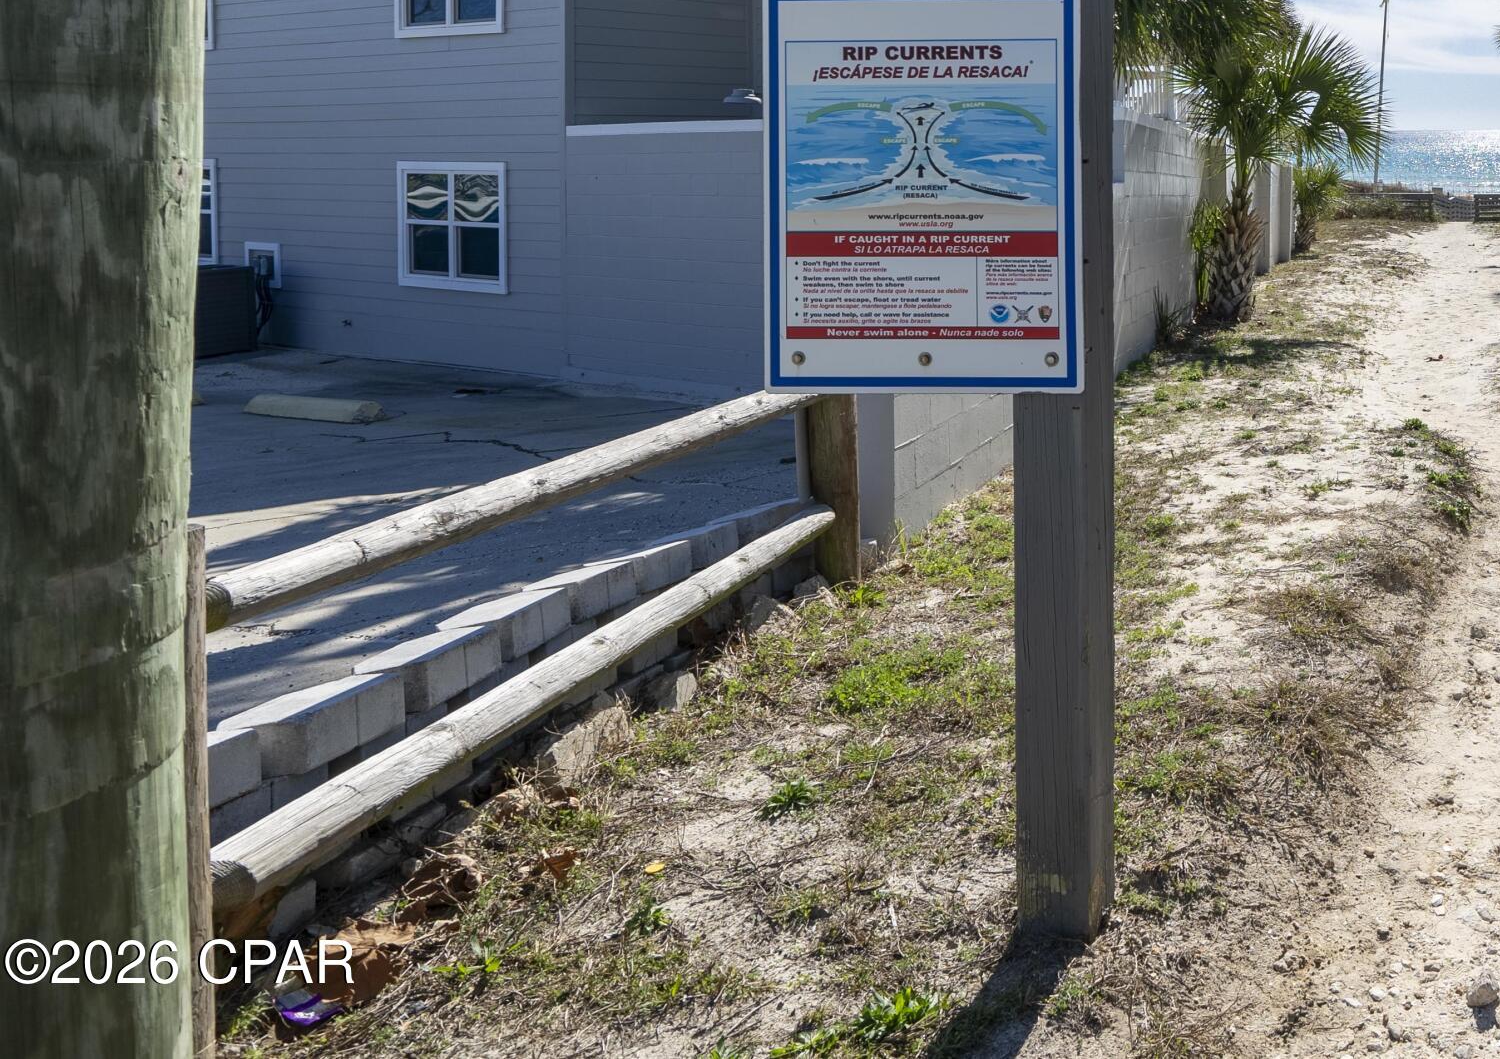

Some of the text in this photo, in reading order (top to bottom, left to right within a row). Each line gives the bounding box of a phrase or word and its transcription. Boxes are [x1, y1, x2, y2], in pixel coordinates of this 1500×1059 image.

[842, 45, 1002, 60] RIP CURRENTS
[813, 64, 1028, 81] ¡ESCÁPESE DE LA RESACA!
[868, 213, 984, 222] www.ripcurrents.noaa.gov
[898, 220, 953, 228] www.usla.org
[827, 328, 860, 336] Never
[863, 328, 894, 336] swim
[897, 328, 929, 336] alone
[939, 328, 971, 336] Nunca
